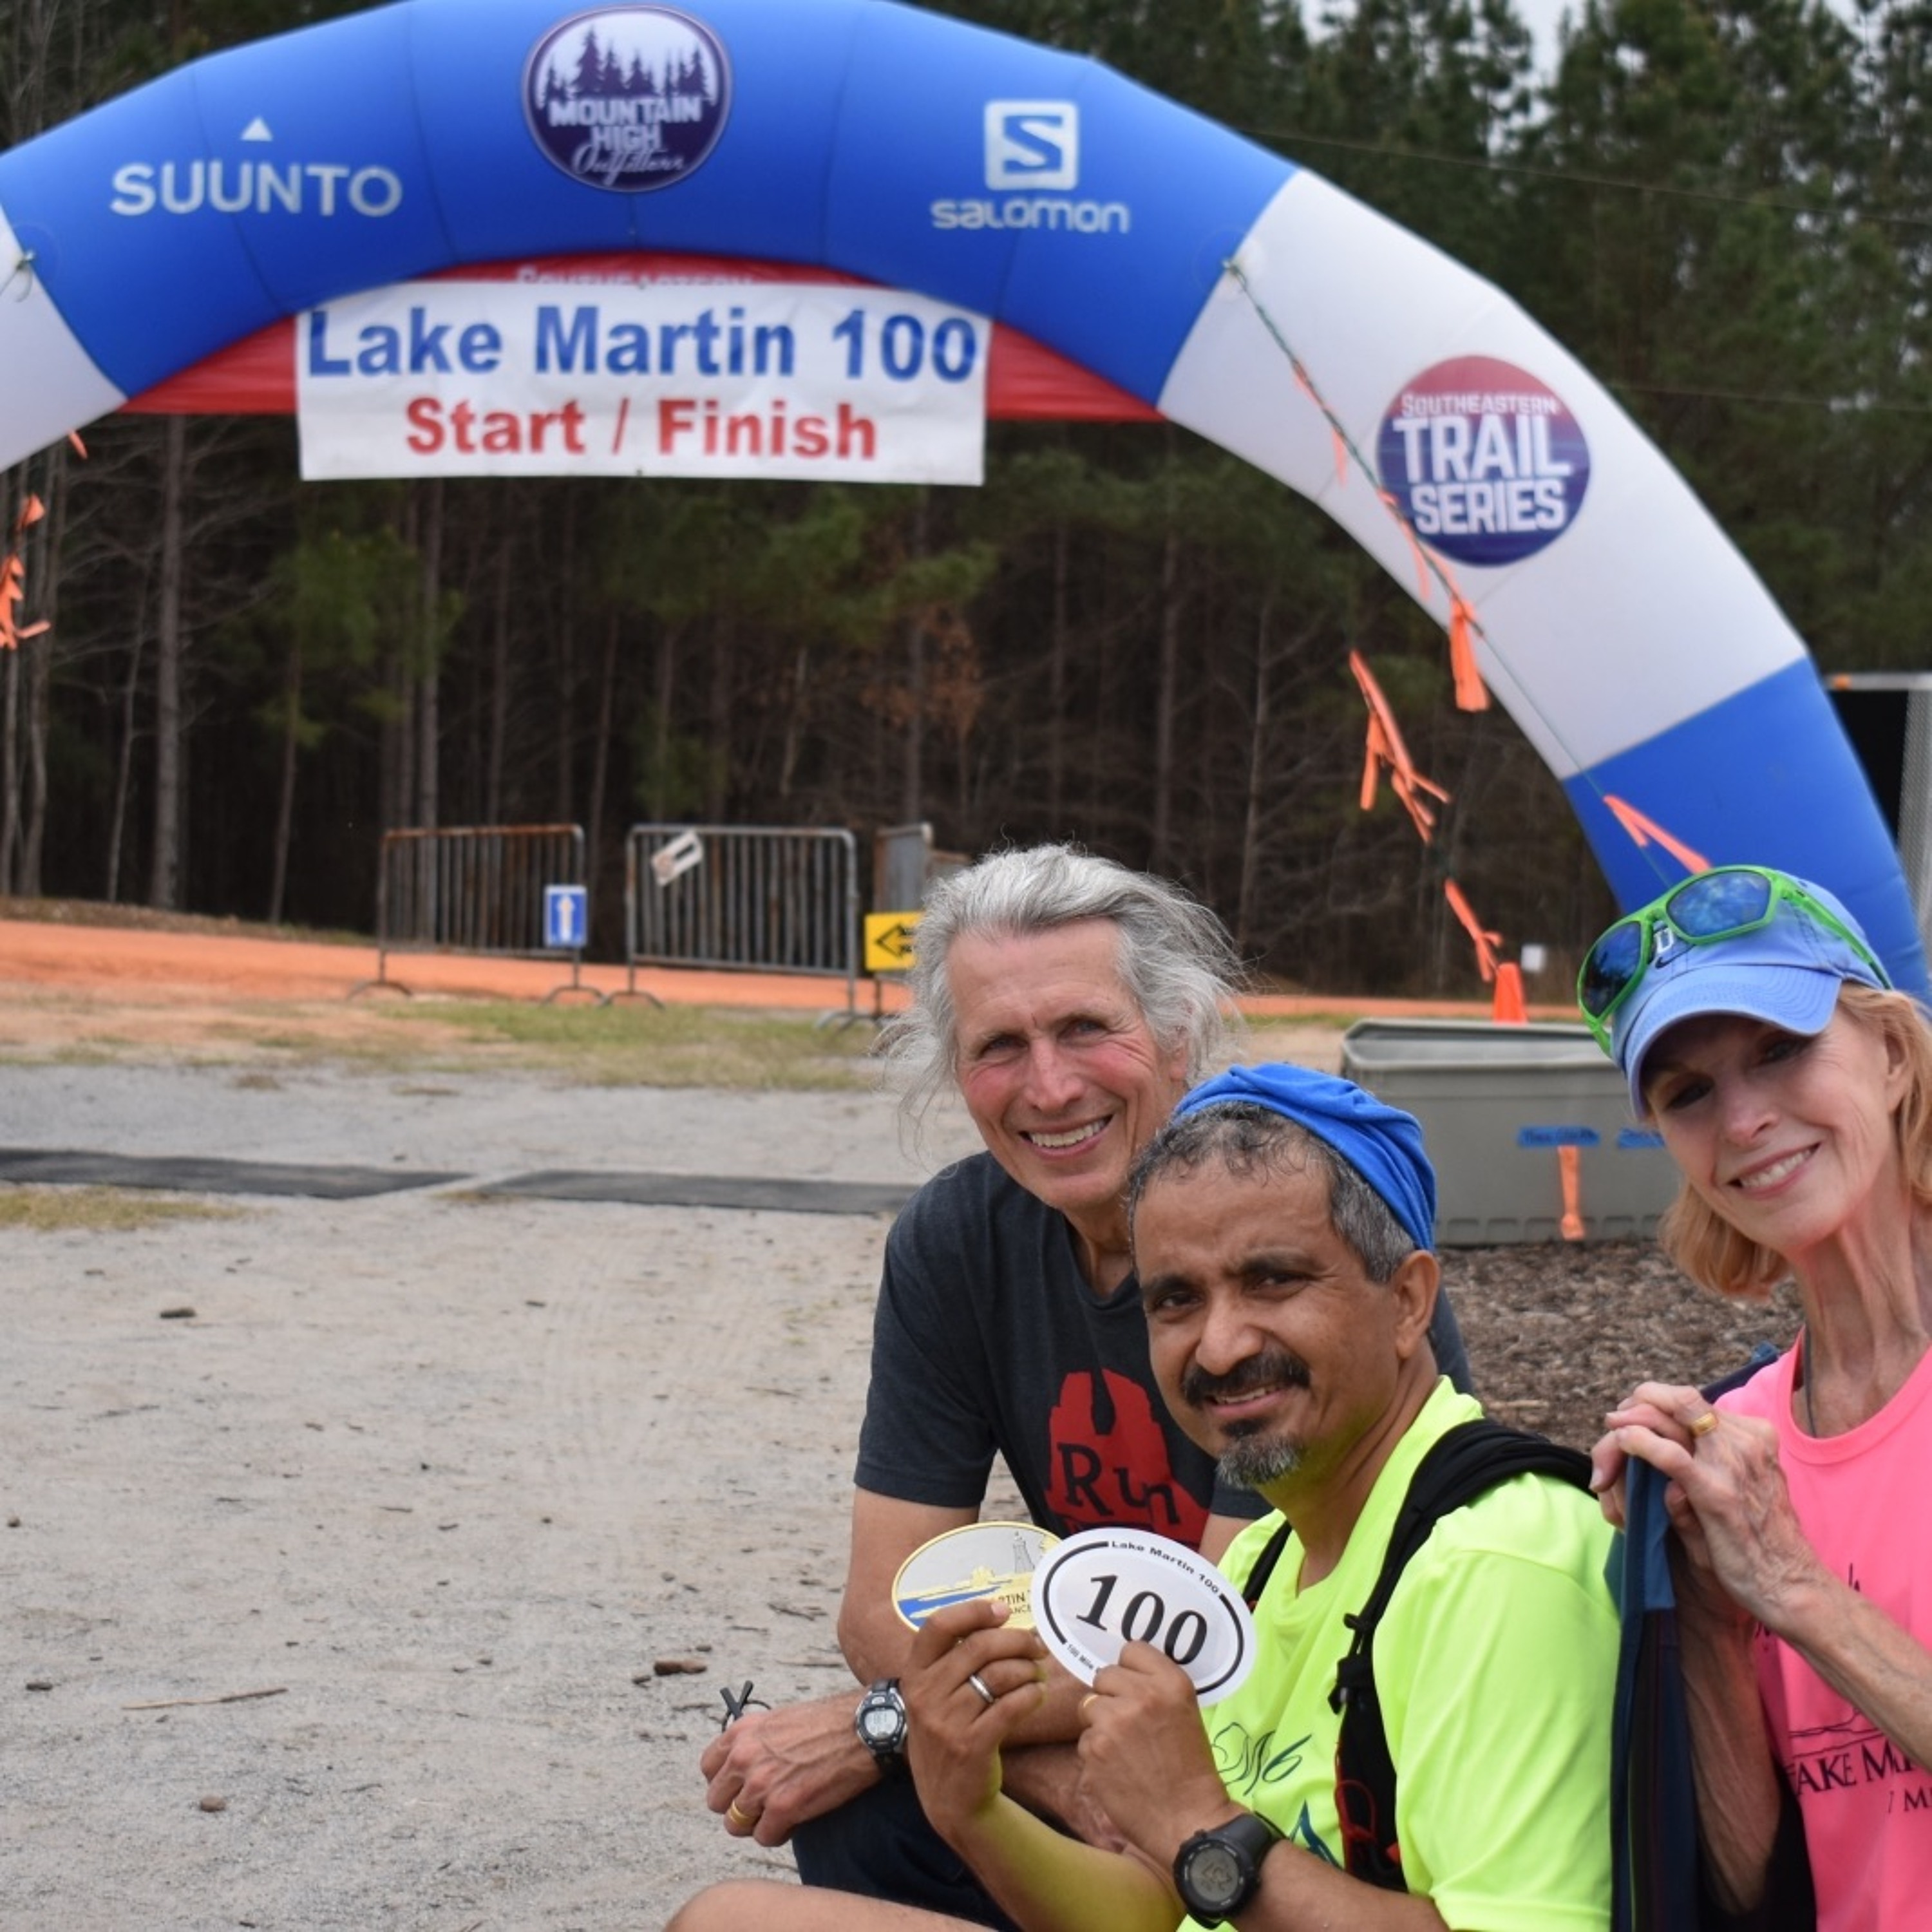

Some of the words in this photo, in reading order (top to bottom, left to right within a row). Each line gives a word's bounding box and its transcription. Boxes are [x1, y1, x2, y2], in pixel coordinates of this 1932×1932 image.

[549, 96, 702, 127] MOUNTAIN
[591, 124, 661, 152] HIGH
[111, 161, 402, 216] SUUNTO
[308, 306, 502, 377] Lake
[535, 305, 796, 377] Martin
[832, 308, 977, 382] 100
[406, 396, 585, 454] Start
[658, 399, 876, 460] Finish
[1392, 413, 1573, 484] TRAIL
[1411, 478, 1566, 534] SERIES
[1057, 1443, 1180, 1525] Run
[1112, 1541, 1144, 1552] Lake
[1150, 1548, 1195, 1574] Martin
[1199, 1573, 1218, 1594] 100
[1076, 1574, 1208, 1665] 100
[1784, 1752, 1857, 1795] AKE
